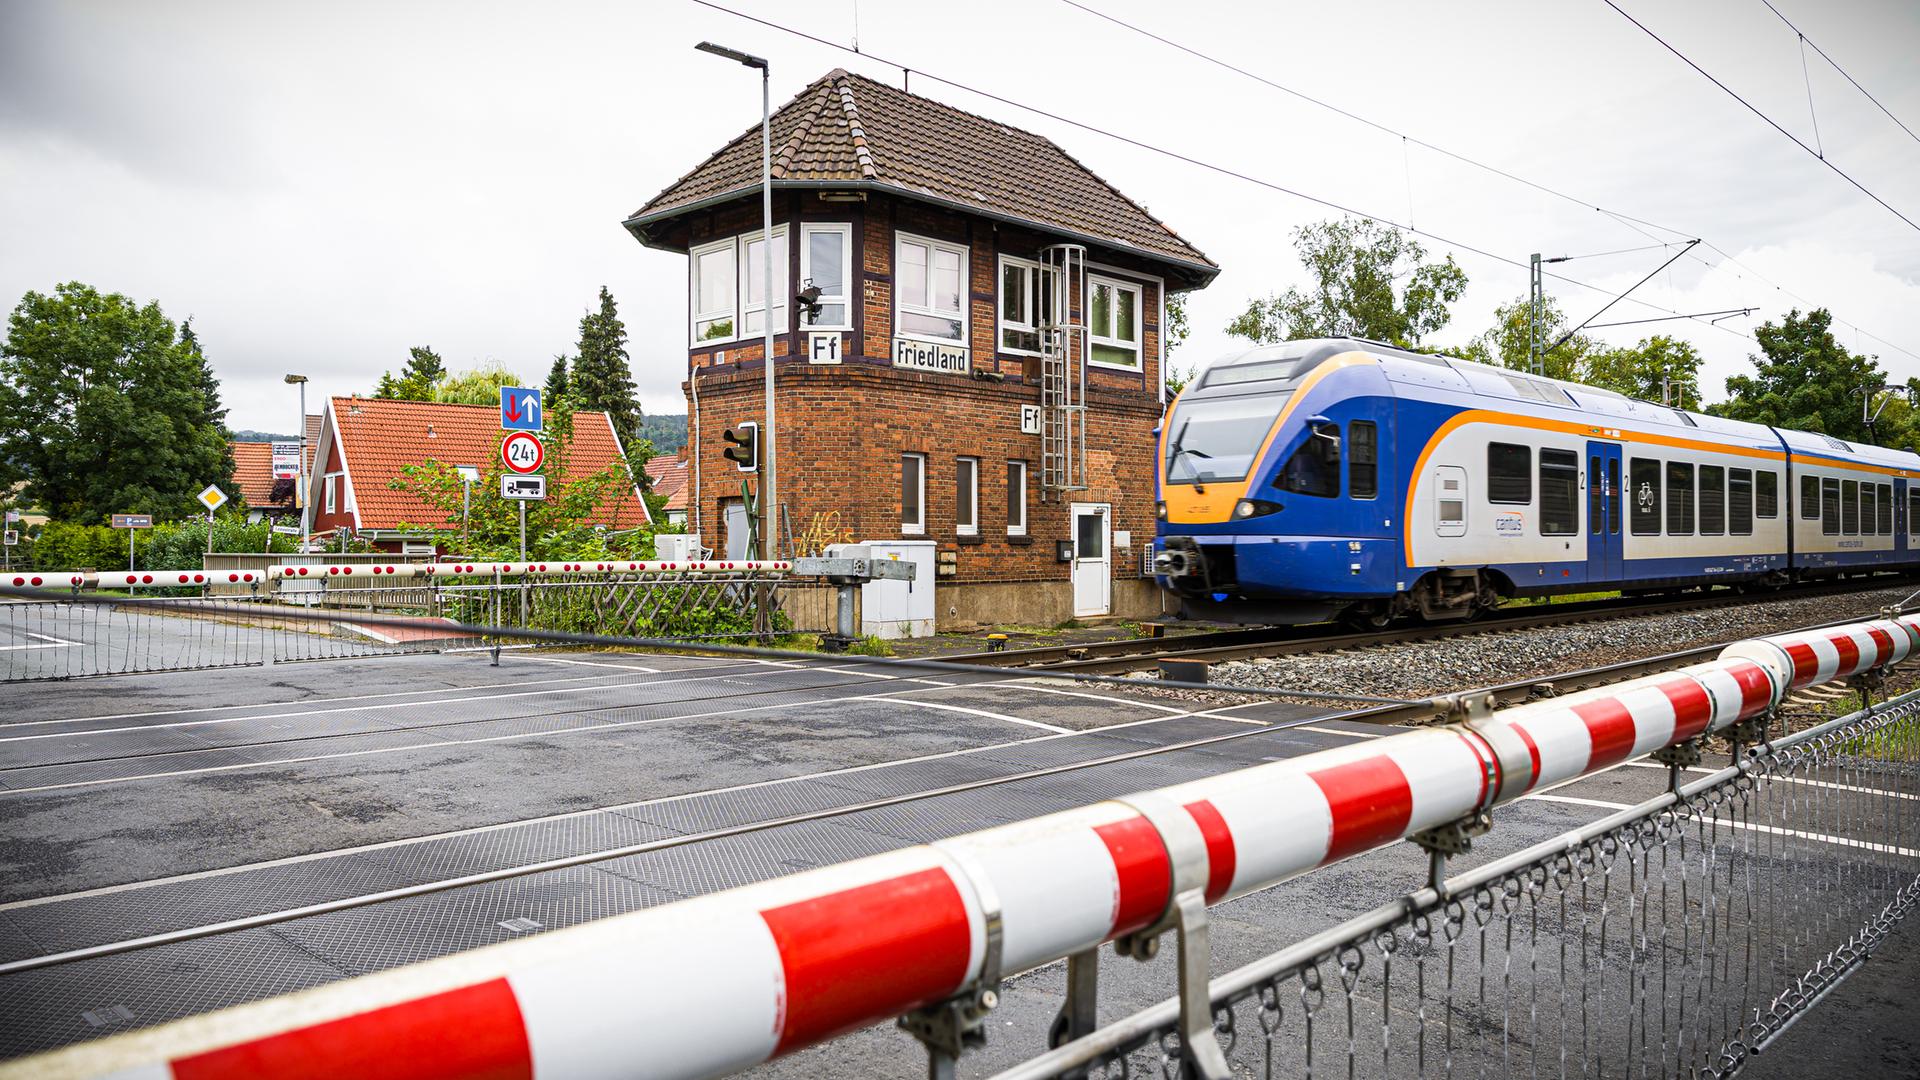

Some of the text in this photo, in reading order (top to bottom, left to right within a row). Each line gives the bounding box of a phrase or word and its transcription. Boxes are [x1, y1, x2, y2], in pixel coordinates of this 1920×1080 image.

[813, 336, 837, 360] Ff
[897, 340, 966, 371] Friedland
[1024, 408, 1039, 430] Ff
[511, 443, 535, 462] 24t
[1580, 471, 1585, 490] 2
[1624, 474, 1629, 492] 2
[807, 510, 841, 541] NO
